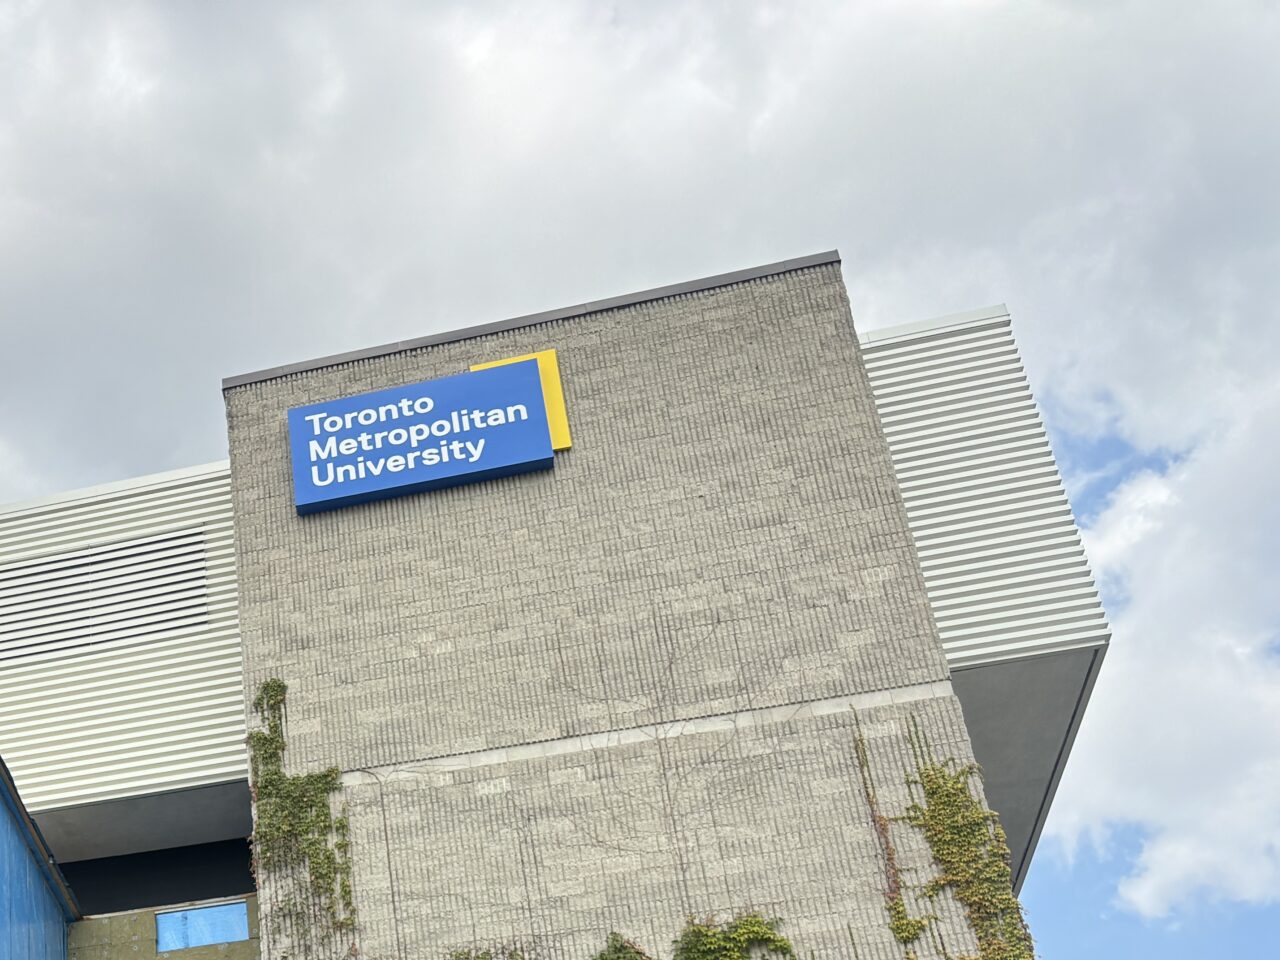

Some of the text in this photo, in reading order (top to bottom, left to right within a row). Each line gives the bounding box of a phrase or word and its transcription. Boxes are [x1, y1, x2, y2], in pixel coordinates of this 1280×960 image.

[305, 397, 434, 436] Toronto
[310, 404, 528, 461] Metropolitan
[311, 438, 485, 486] University
